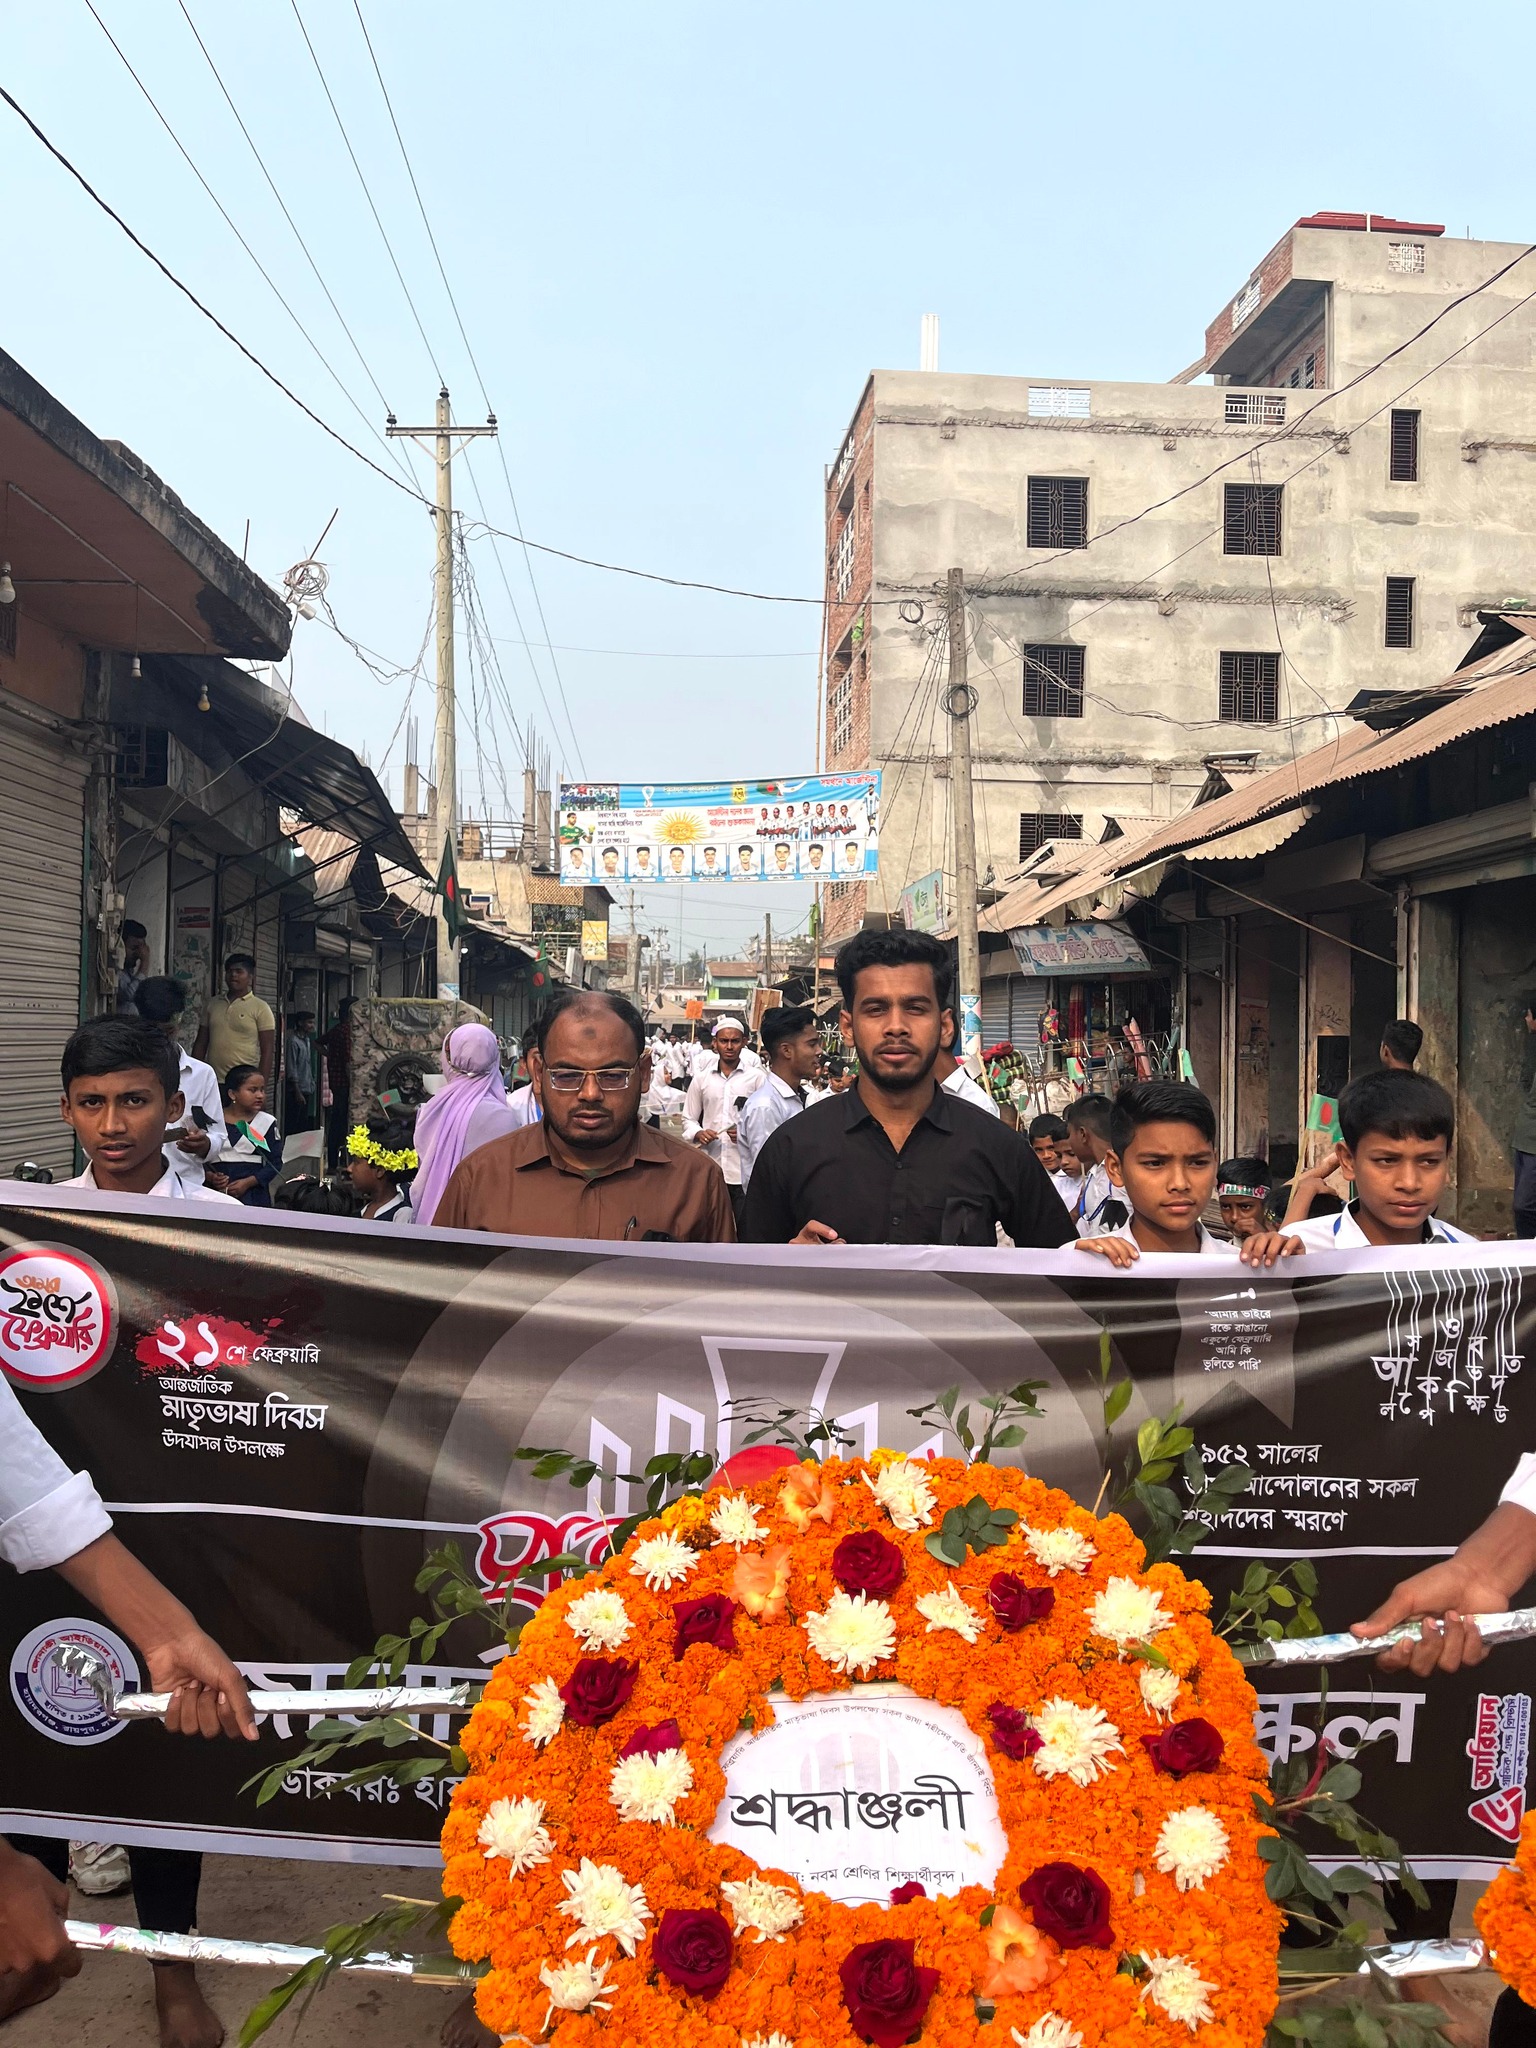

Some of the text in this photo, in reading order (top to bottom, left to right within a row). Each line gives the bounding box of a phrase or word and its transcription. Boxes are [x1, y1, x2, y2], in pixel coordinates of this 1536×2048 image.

[15, 1274, 61, 1294] অমর
[156, 1321, 321, 1372] ২১ শে ফেব্রুয়ারি
[1215, 1344, 1237, 1355] আমি
[1202, 1357, 1235, 1371] ভুলিতে
[158, 1375, 233, 1396] আন্তর্জাতিক
[160, 1391, 329, 1431] মাতৃভাষা দিবস
[161, 1428, 285, 1459] উদযাপন উপলক্ষে
[1201, 1442, 1323, 1467] ৯৫২ সালের
[1366, 1477, 1419, 1499] সকল
[1281, 1509, 1349, 1532] স্মরণে
[1469, 1696, 1499, 1788] আরিয়ান
[728, 1774, 975, 1835] শ্রদ্ধাঞ্জলী
[809, 1869, 838, 1883] নবম
[843, 1864, 880, 1881] শ্রেণির
[885, 1866, 955, 1888] শিক্ষার্থীবৃন্দ
